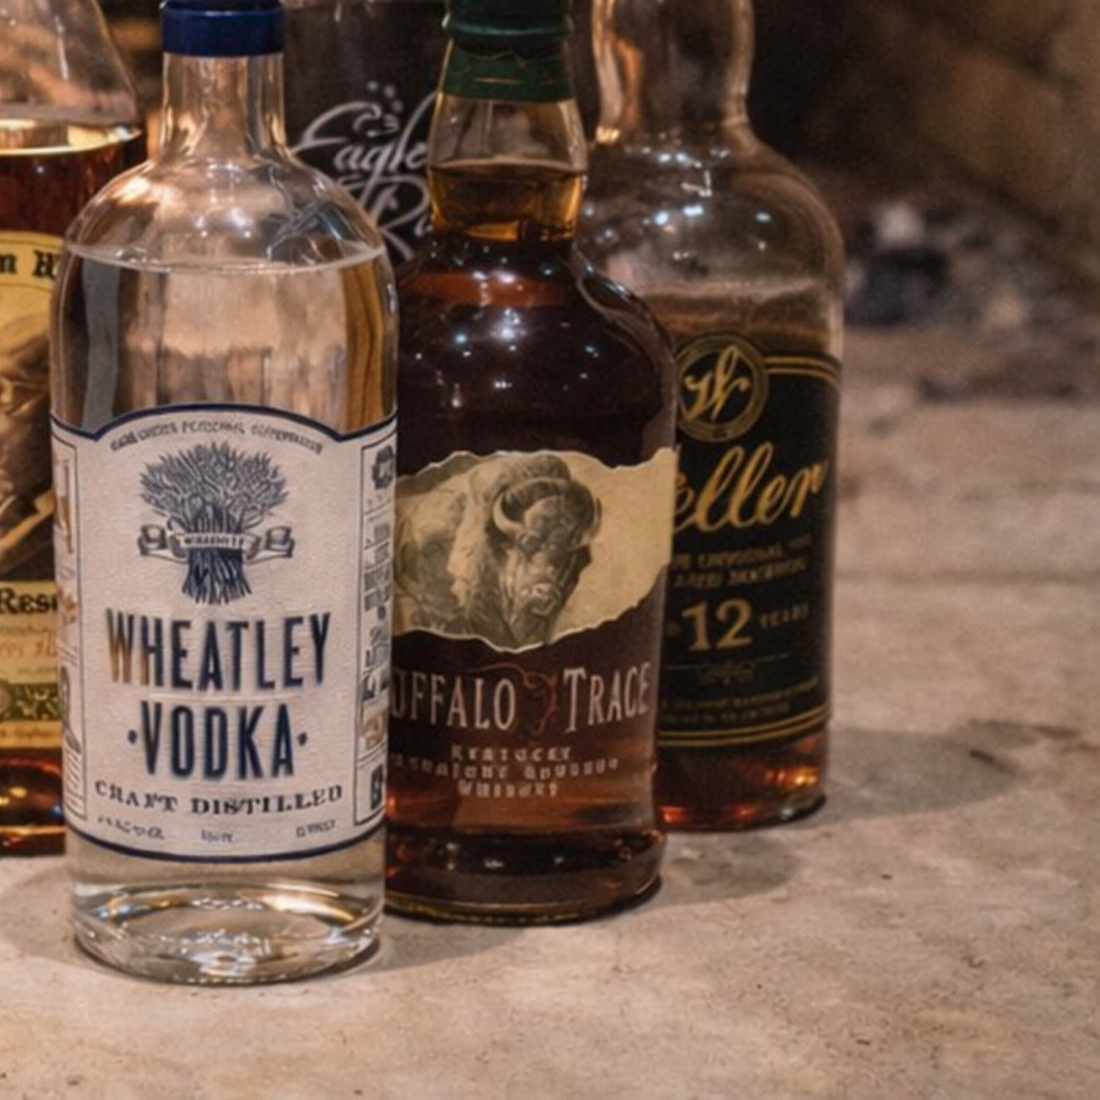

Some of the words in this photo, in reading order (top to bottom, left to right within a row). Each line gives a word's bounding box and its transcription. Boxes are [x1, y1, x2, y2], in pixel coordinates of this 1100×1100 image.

[290, 91, 437, 208] Eagle
[676, 441, 826, 533] eller
[106, 608, 332, 691] WHEATLEY
[681, 597, 753, 652] 12
[390, 666, 517, 730] UFFALO
[563, 661, 651, 733] TRACE
[141, 701, 295, 780] VODKA
[95, 780, 178, 813] CRAFT
[191, 784, 343, 815] DISTILLED
